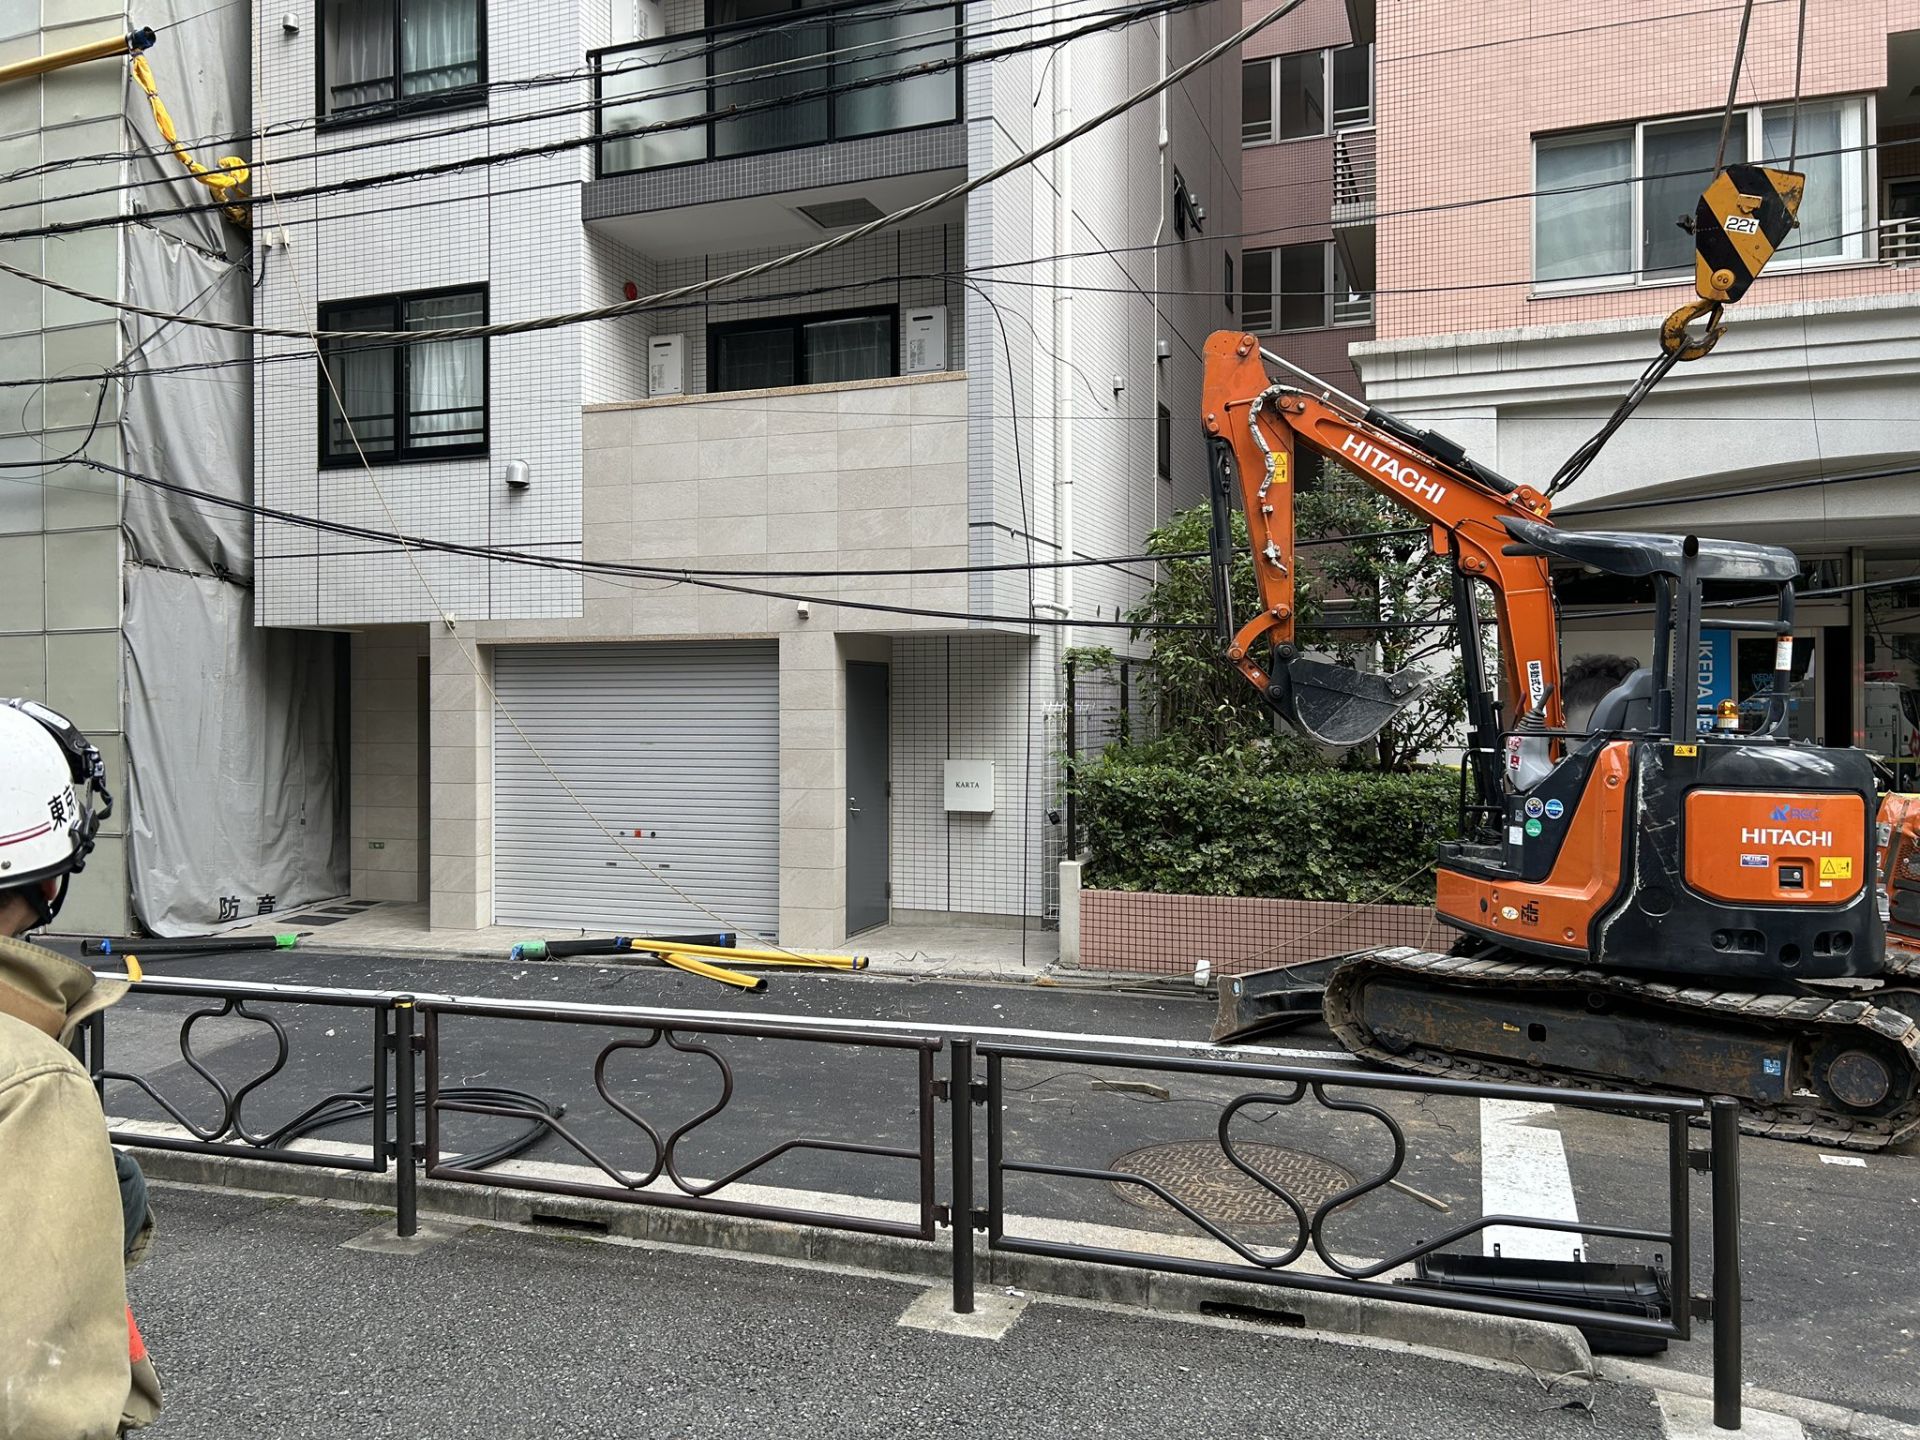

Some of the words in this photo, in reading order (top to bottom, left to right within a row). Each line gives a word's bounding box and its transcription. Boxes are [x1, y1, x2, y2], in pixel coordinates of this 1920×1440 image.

[1726, 217, 1756, 233] 22t
[1341, 433, 1446, 505] HITACHI
[1697, 640, 1713, 699] IKEDA
[1529, 662, 1542, 704] 移動式クレ
[955, 781, 980, 789] KARTA
[1741, 827, 1832, 847] HITACHI
[218, 894, 276, 920] 防音
